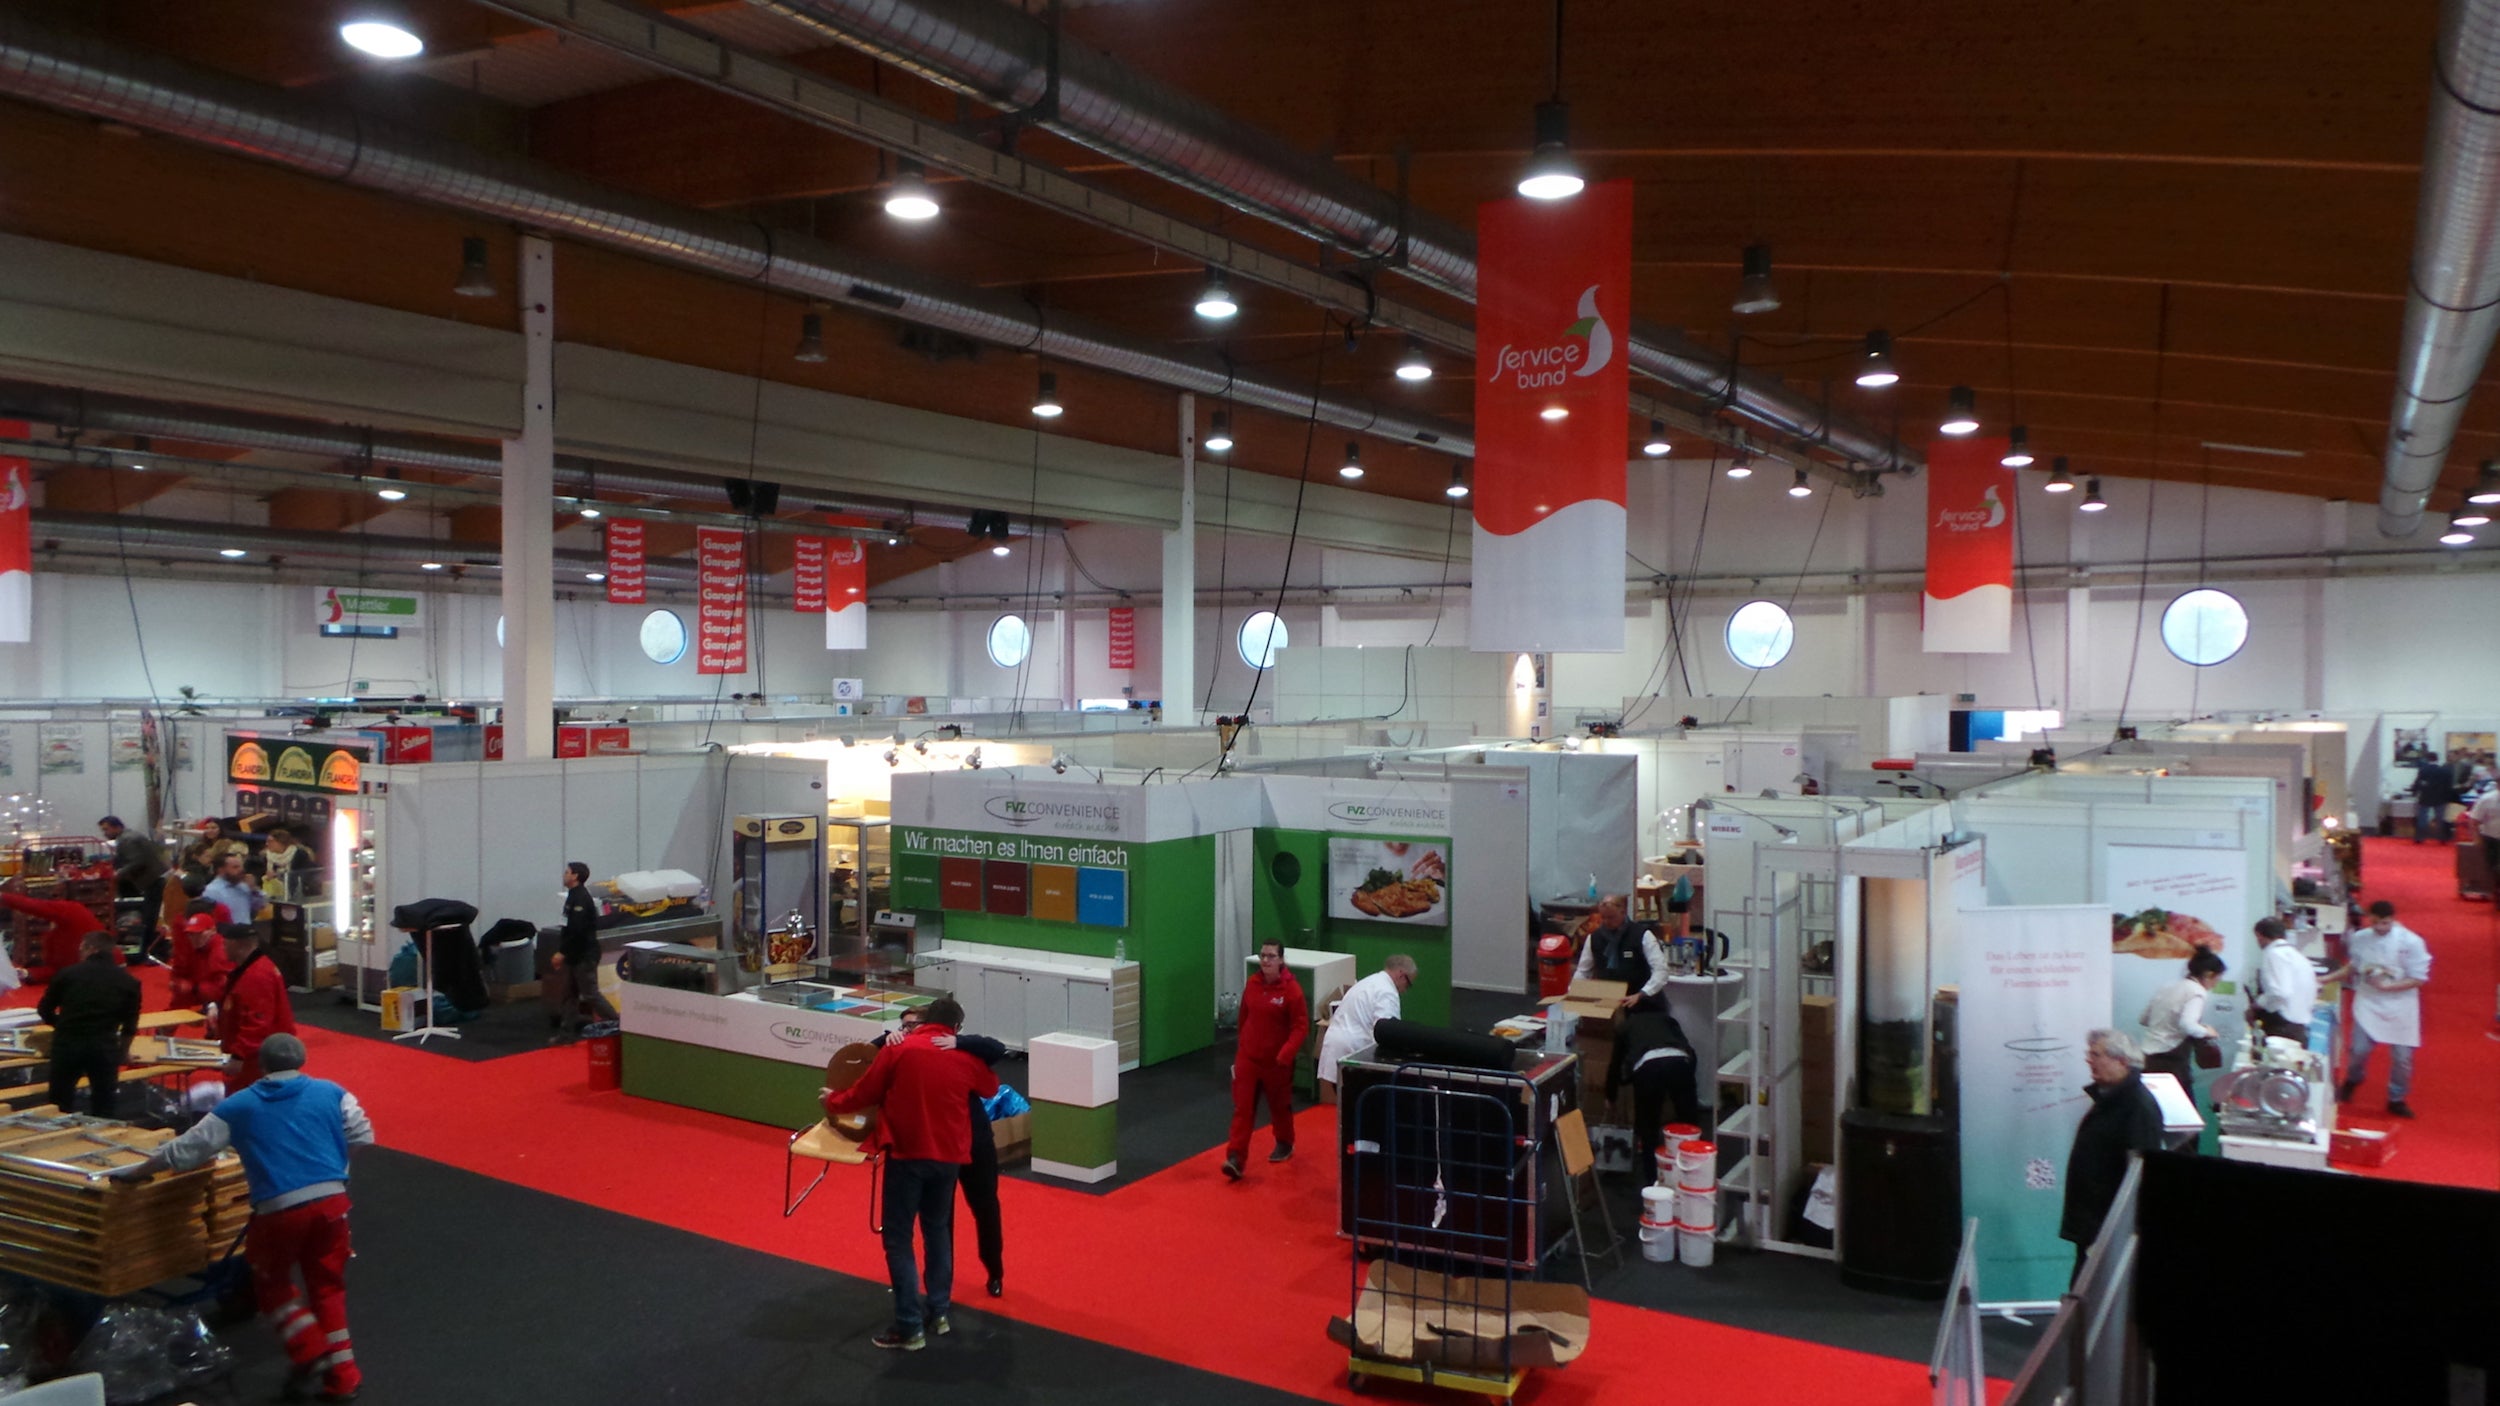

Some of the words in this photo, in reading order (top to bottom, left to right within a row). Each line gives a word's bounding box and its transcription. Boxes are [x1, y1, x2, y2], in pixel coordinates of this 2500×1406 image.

[1517, 364, 1567, 389] bund
[282, 767, 312, 779] FLANDRIA
[1710, 825, 1741, 833] WIBERG
[904, 831, 929, 850] Wir
[933, 835, 993, 856] machen
[997, 842, 1016, 857] es
[1020, 839, 1064, 862] Ihnen
[1068, 844, 1128, 866] einfach
